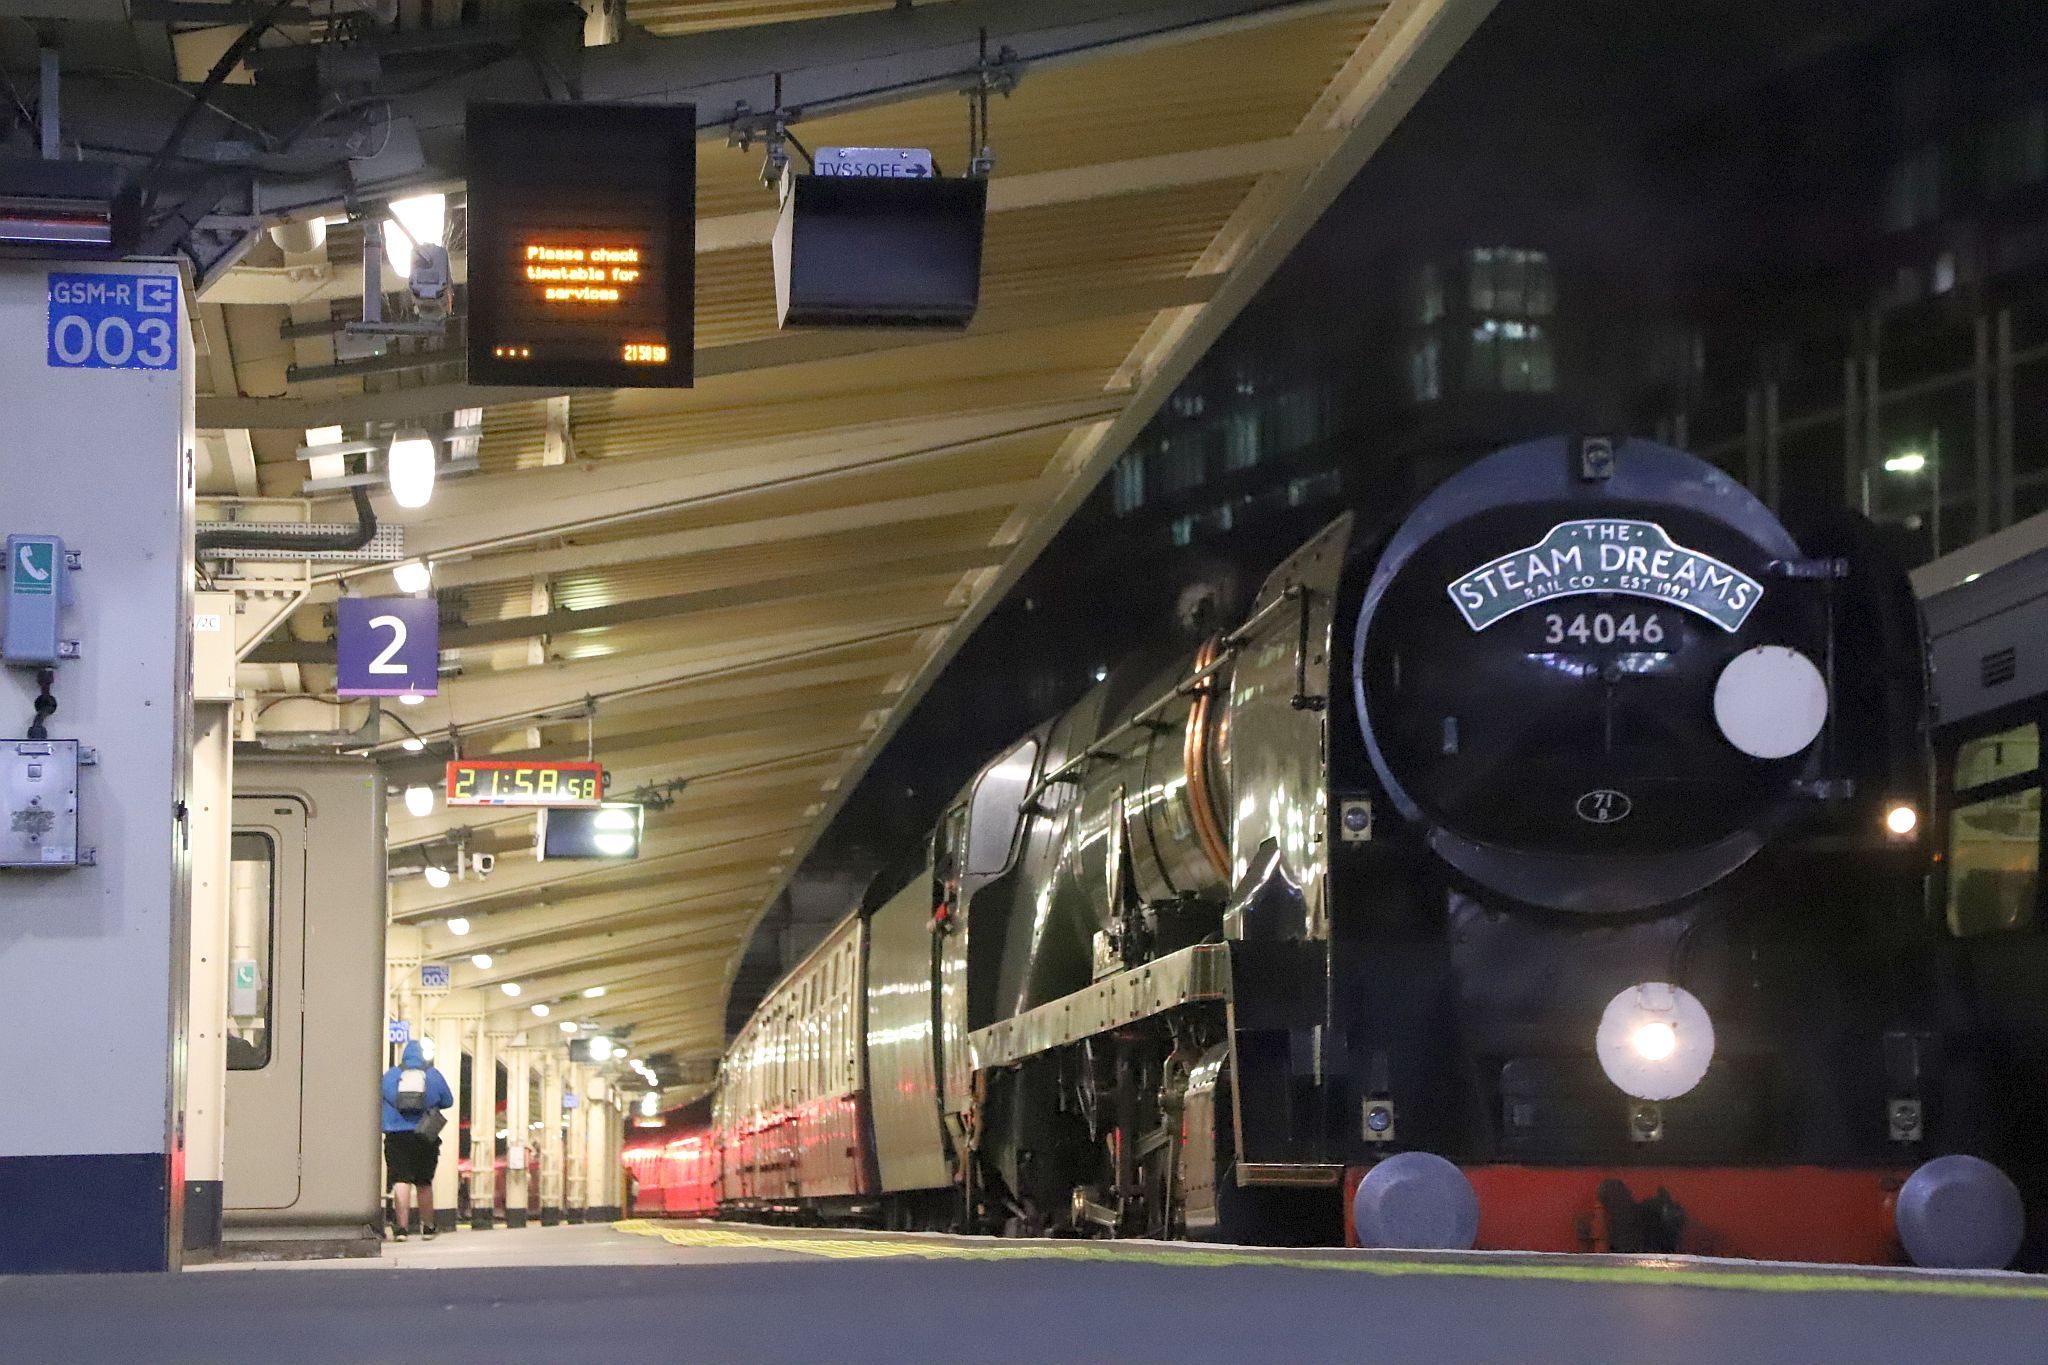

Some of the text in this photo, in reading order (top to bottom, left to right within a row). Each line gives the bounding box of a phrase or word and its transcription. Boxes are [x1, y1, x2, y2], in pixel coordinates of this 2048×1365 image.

[527, 246, 638, 262] Please check
[527, 266, 639, 281] timetable for
[54, 282, 131, 305] GSM-R
[545, 287, 618, 300] services
[54, 315, 172, 366] 003
[1584, 524, 1630, 541] THE
[1459, 543, 1751, 610] STEAM DREAMS
[1524, 575, 1689, 601] RAIL CO EST 1999
[1545, 613, 1665, 645] 34046
[368, 615, 408, 674] 2
[1594, 794, 1612, 808] 71
